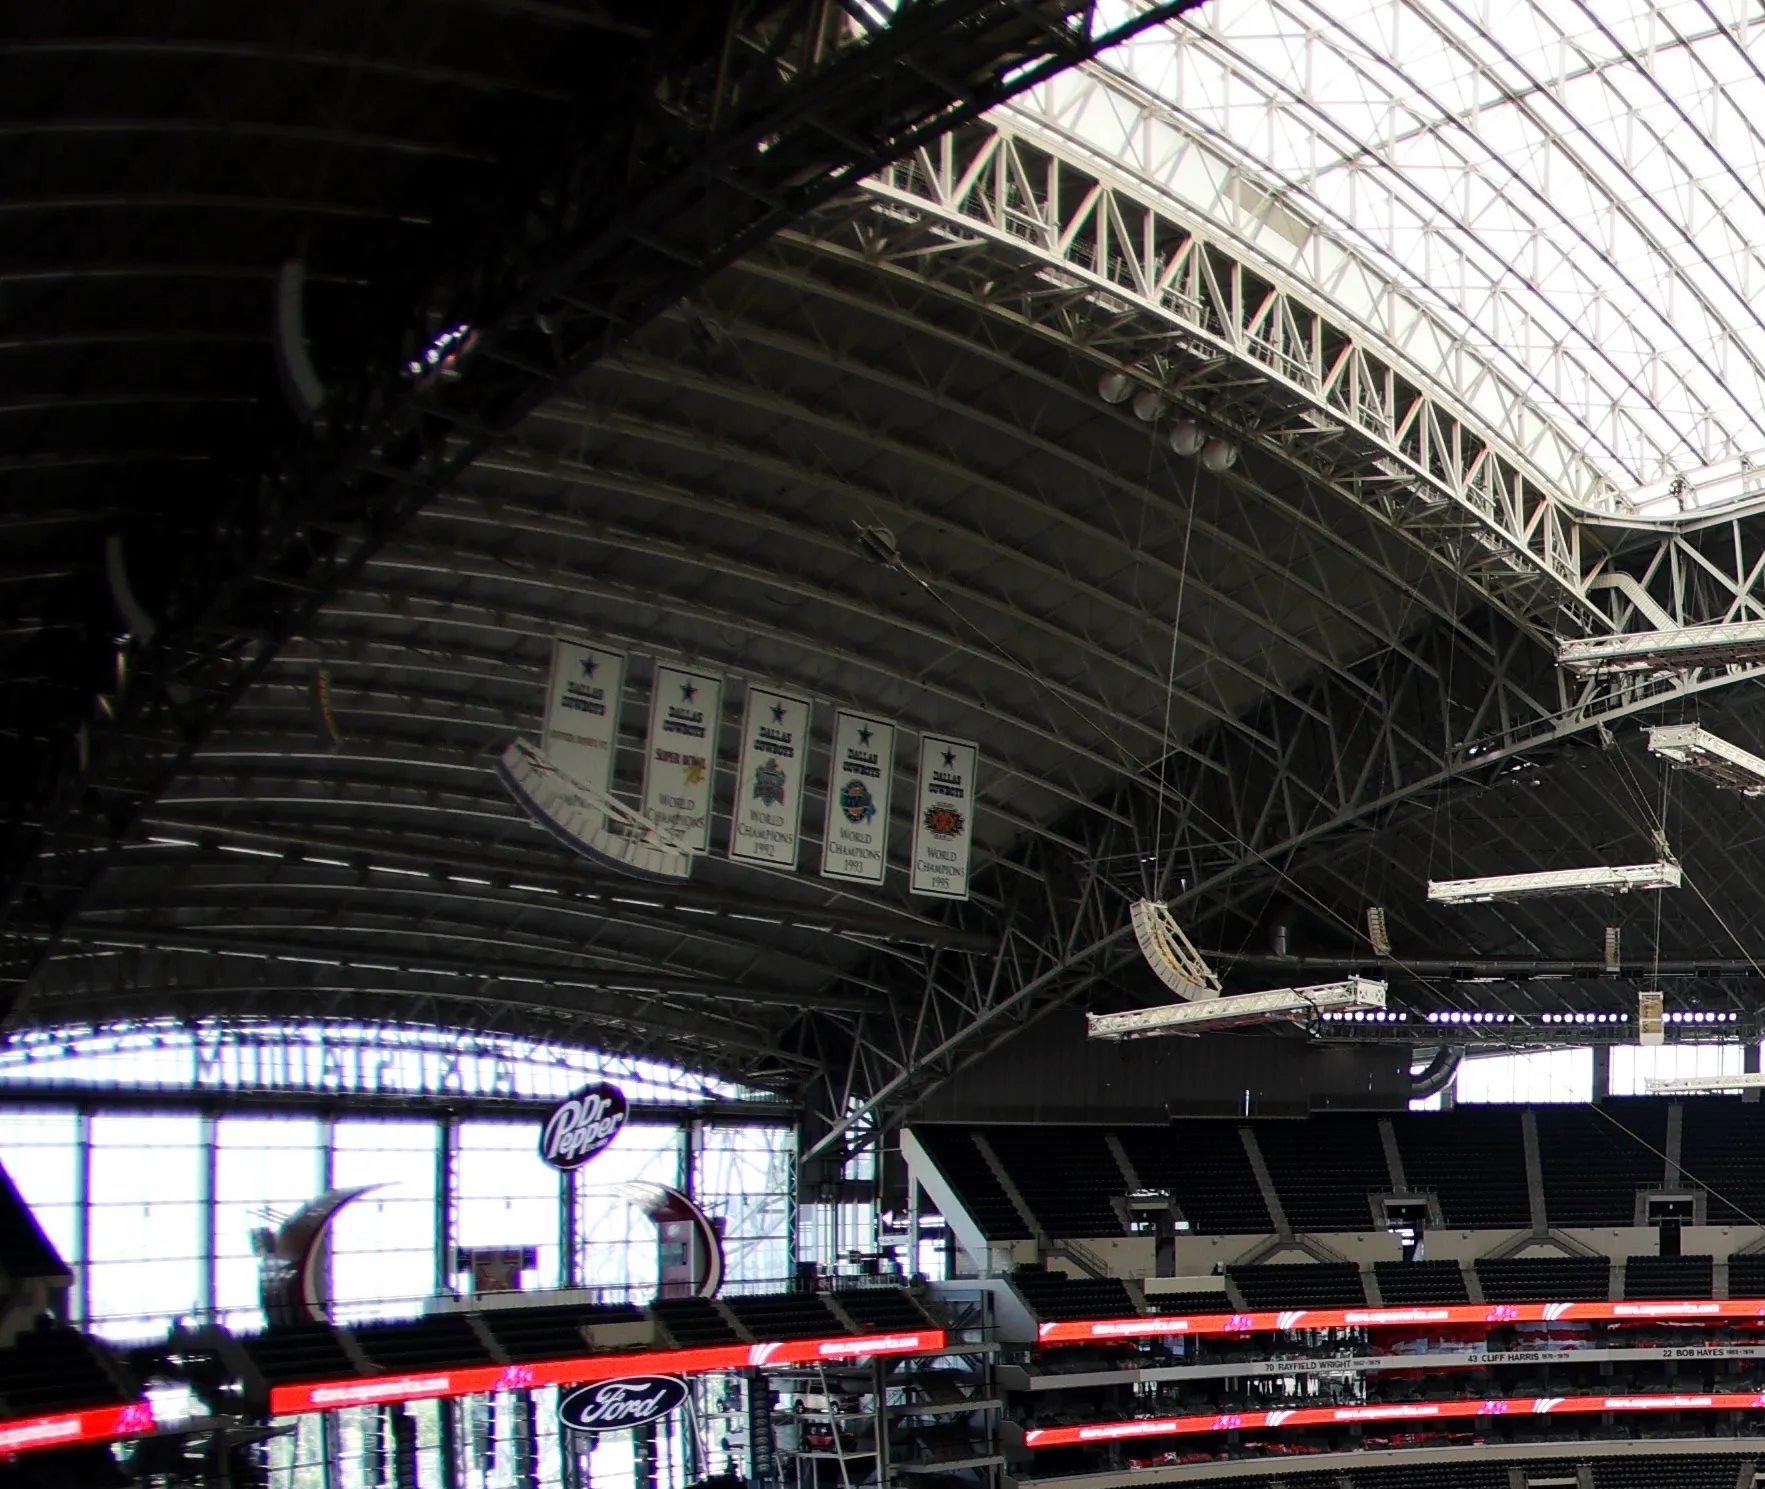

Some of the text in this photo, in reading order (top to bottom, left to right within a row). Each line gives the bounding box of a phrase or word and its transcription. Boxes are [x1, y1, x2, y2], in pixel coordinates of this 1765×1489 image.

[760, 726, 792, 744] DALLAS
[655, 748, 680, 765] SUPER
[754, 739, 794, 758] COWBOYS
[848, 748, 879, 765] DALLAS
[843, 761, 881, 779] COWBOYS
[933, 771, 962, 786] DALLAS
[929, 783, 964, 799] COWBOYS
[659, 793, 695, 810] WORLD
[751, 810, 784, 826] WORLD
[737, 823, 793, 844] CHAMPIONS
[840, 828, 872, 844] WORLD
[753, 842, 775, 857] 1992
[829, 841, 881, 861] CHAMPIONS
[928, 846, 957, 862] WORLD
[844, 859, 864, 874] 1993
[917, 860, 964, 878] CHAMPIONS
[931, 877, 949, 889] 1995
[578, 1093, 612, 1127] Dr
[543, 1100, 624, 1160] Pepper
[1345, 1309, 1448, 1323] store.copaamerica.com
[1614, 1302, 1719, 1315] store.copaamerica.com
[1092, 1319, 1188, 1335] store.copaamerica.com
[820, 1337, 918, 1354] store.copaamerica.com
[1662, 1348, 1725, 1358] 22 BOB HAYES
[1467, 1352, 1540, 1362] 43 CLIFF HARRIS
[1278, 1360, 1351, 1371] RAYFIELD WRIGHT
[581, 1382, 668, 1424] Ford
[1605, 1397, 1711, 1408] store.copaamerica.com
[1335, 1406, 1438, 1418] store.copaamerica.com
[1080, 1423, 1176, 1438] store.copaamerica.com
